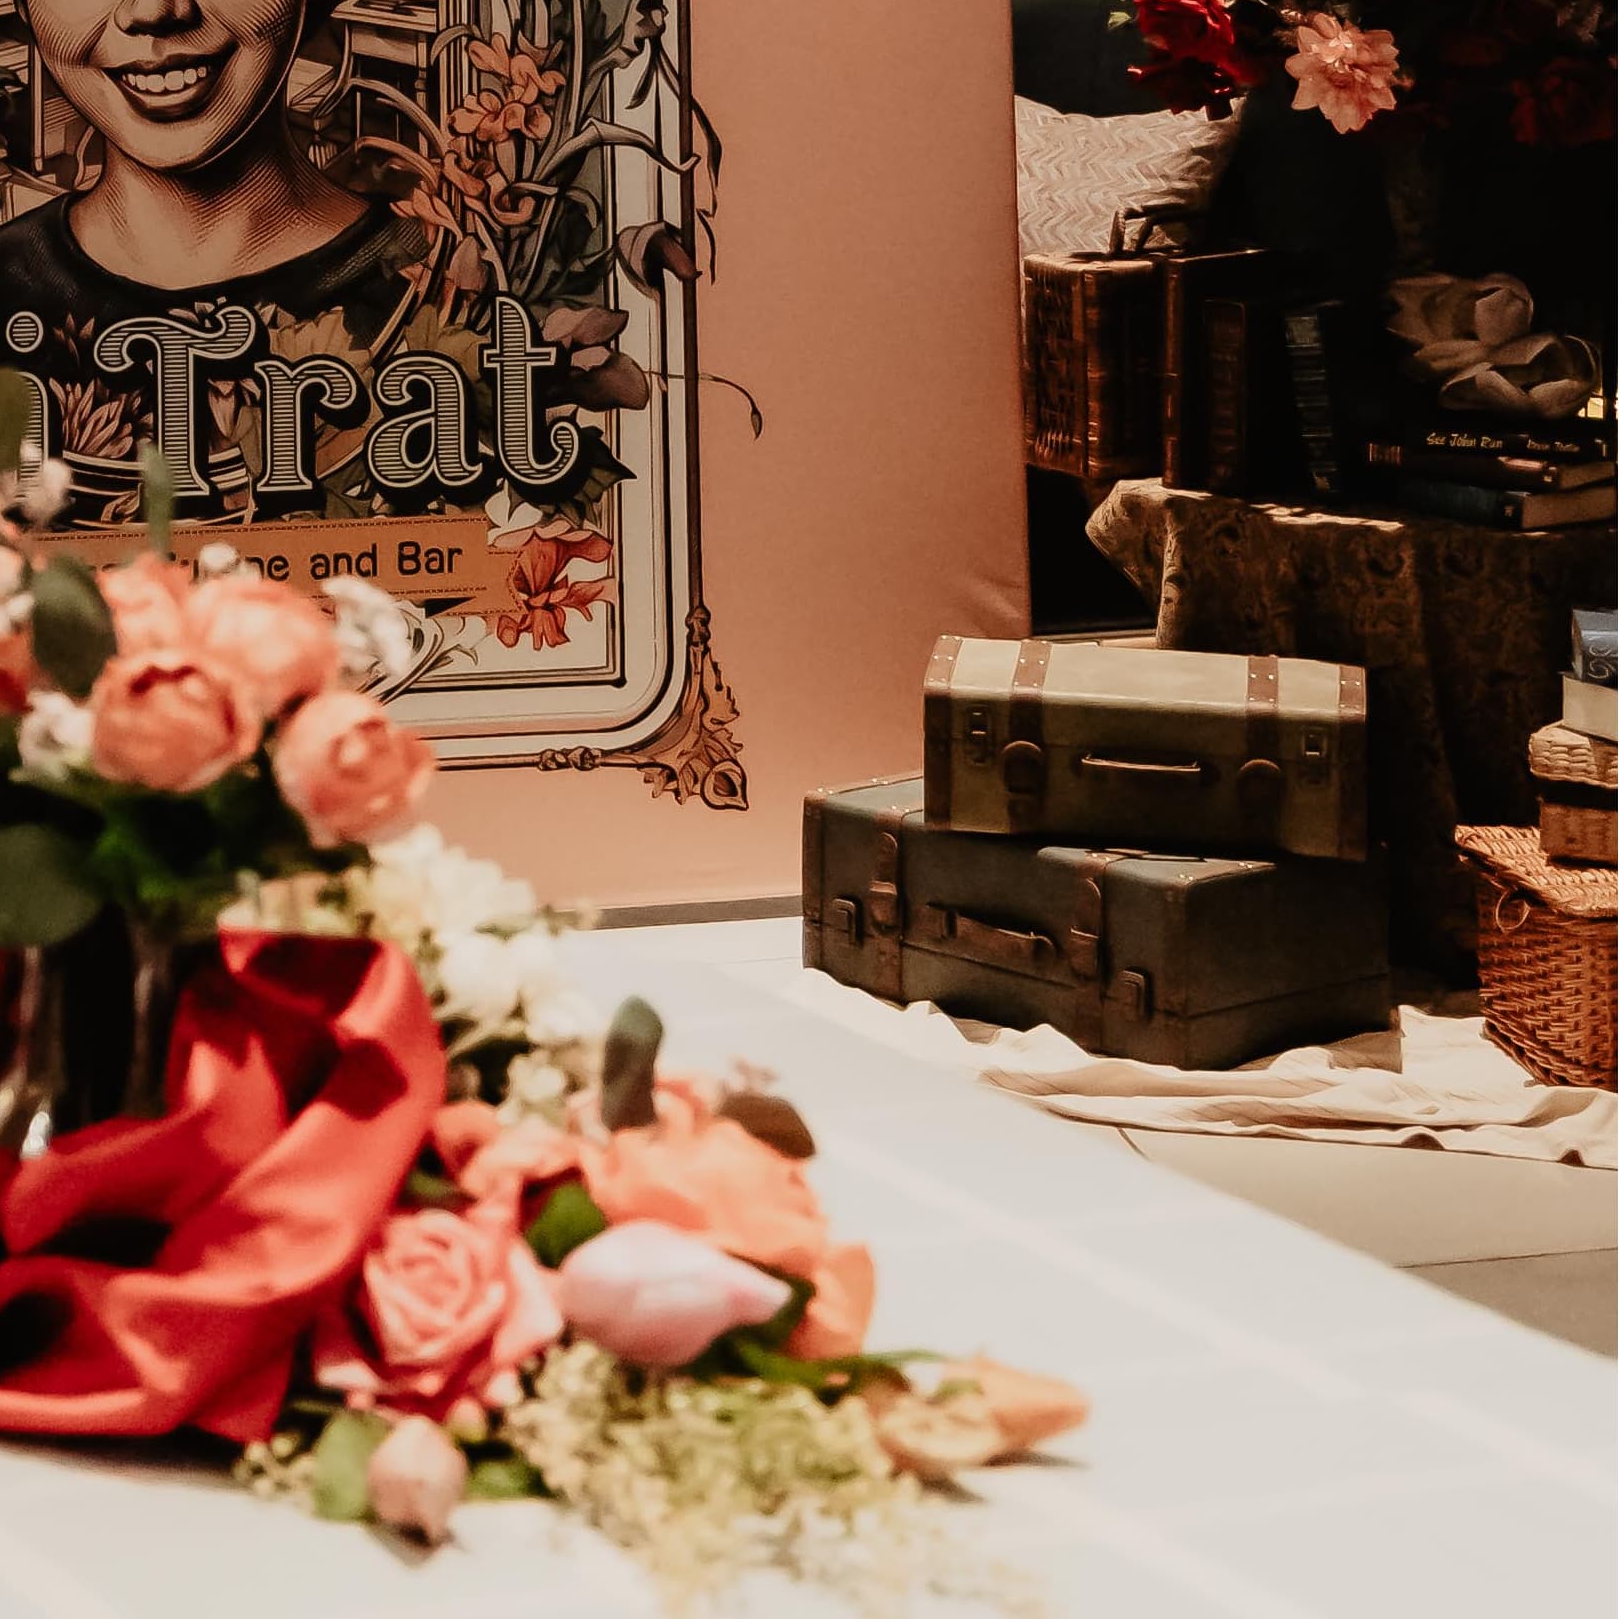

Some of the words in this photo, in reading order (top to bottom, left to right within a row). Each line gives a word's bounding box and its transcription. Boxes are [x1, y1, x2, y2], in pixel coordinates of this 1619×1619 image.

[93, 296, 580, 499] Trat
[309, 542, 378, 580] and
[397, 540, 463, 576] Bar
